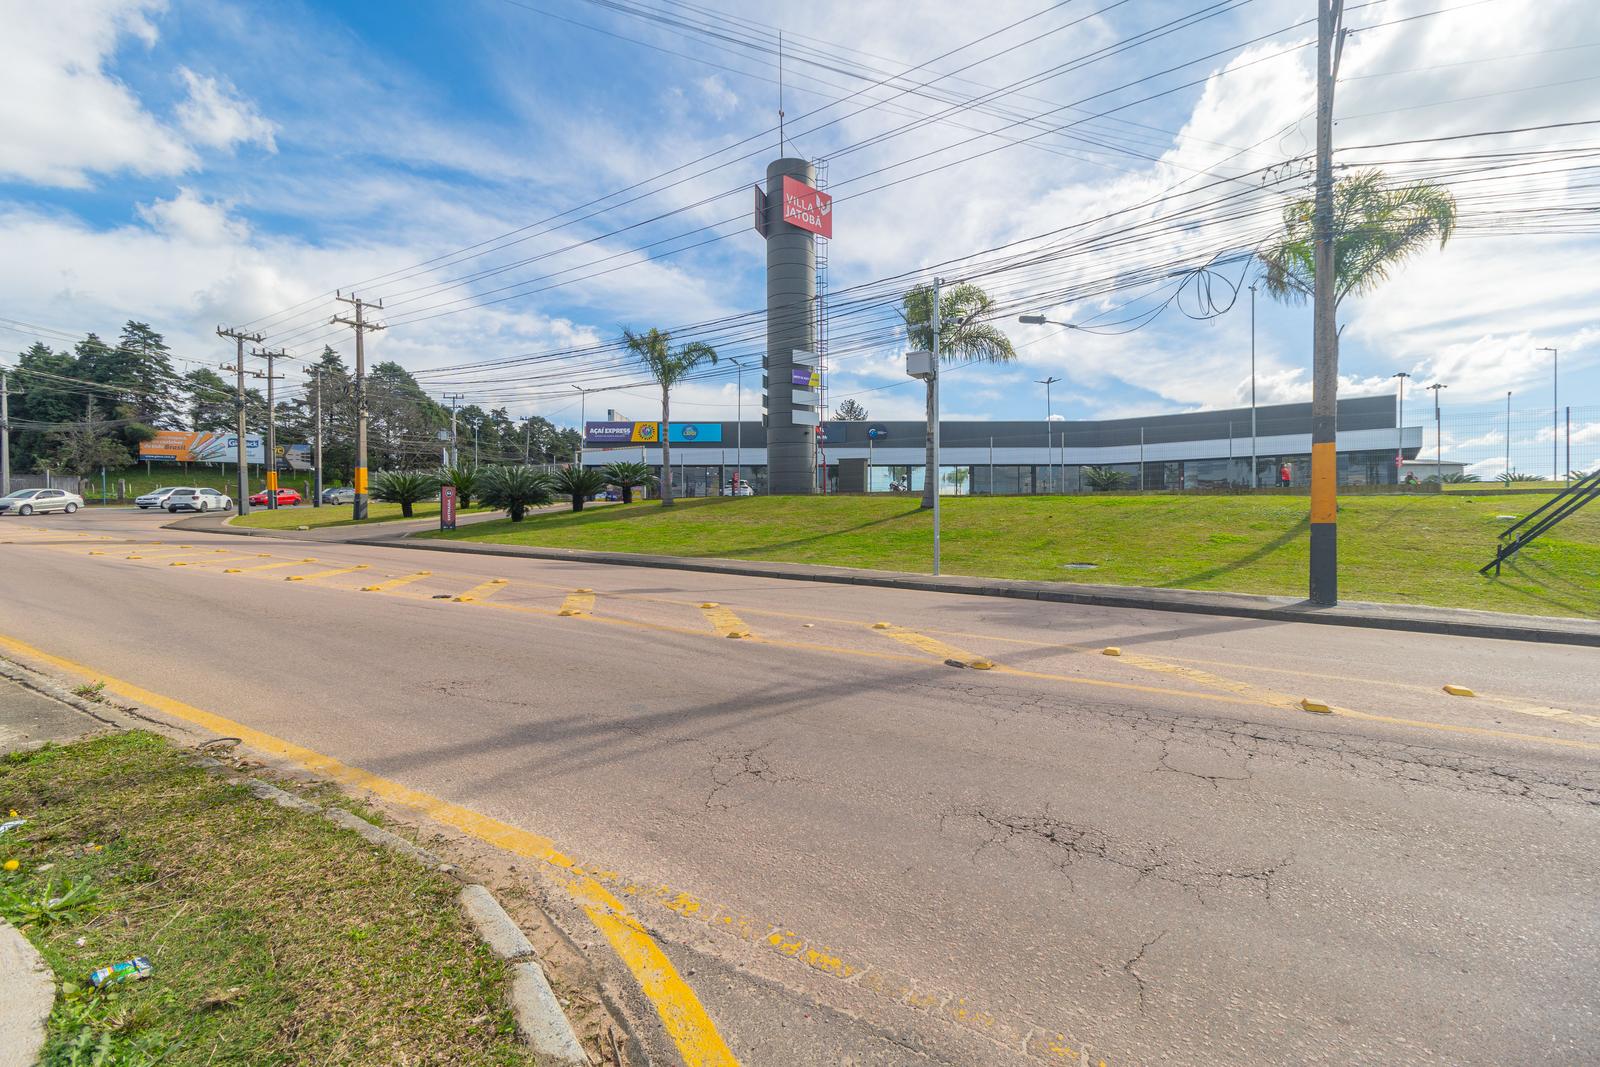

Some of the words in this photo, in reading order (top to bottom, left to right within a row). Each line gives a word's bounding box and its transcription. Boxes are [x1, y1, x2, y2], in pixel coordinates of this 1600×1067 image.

[786, 193, 814, 213] VILLA
[786, 204, 822, 228] JATOBÁ
[589, 426, 603, 435] AÇAÍ
